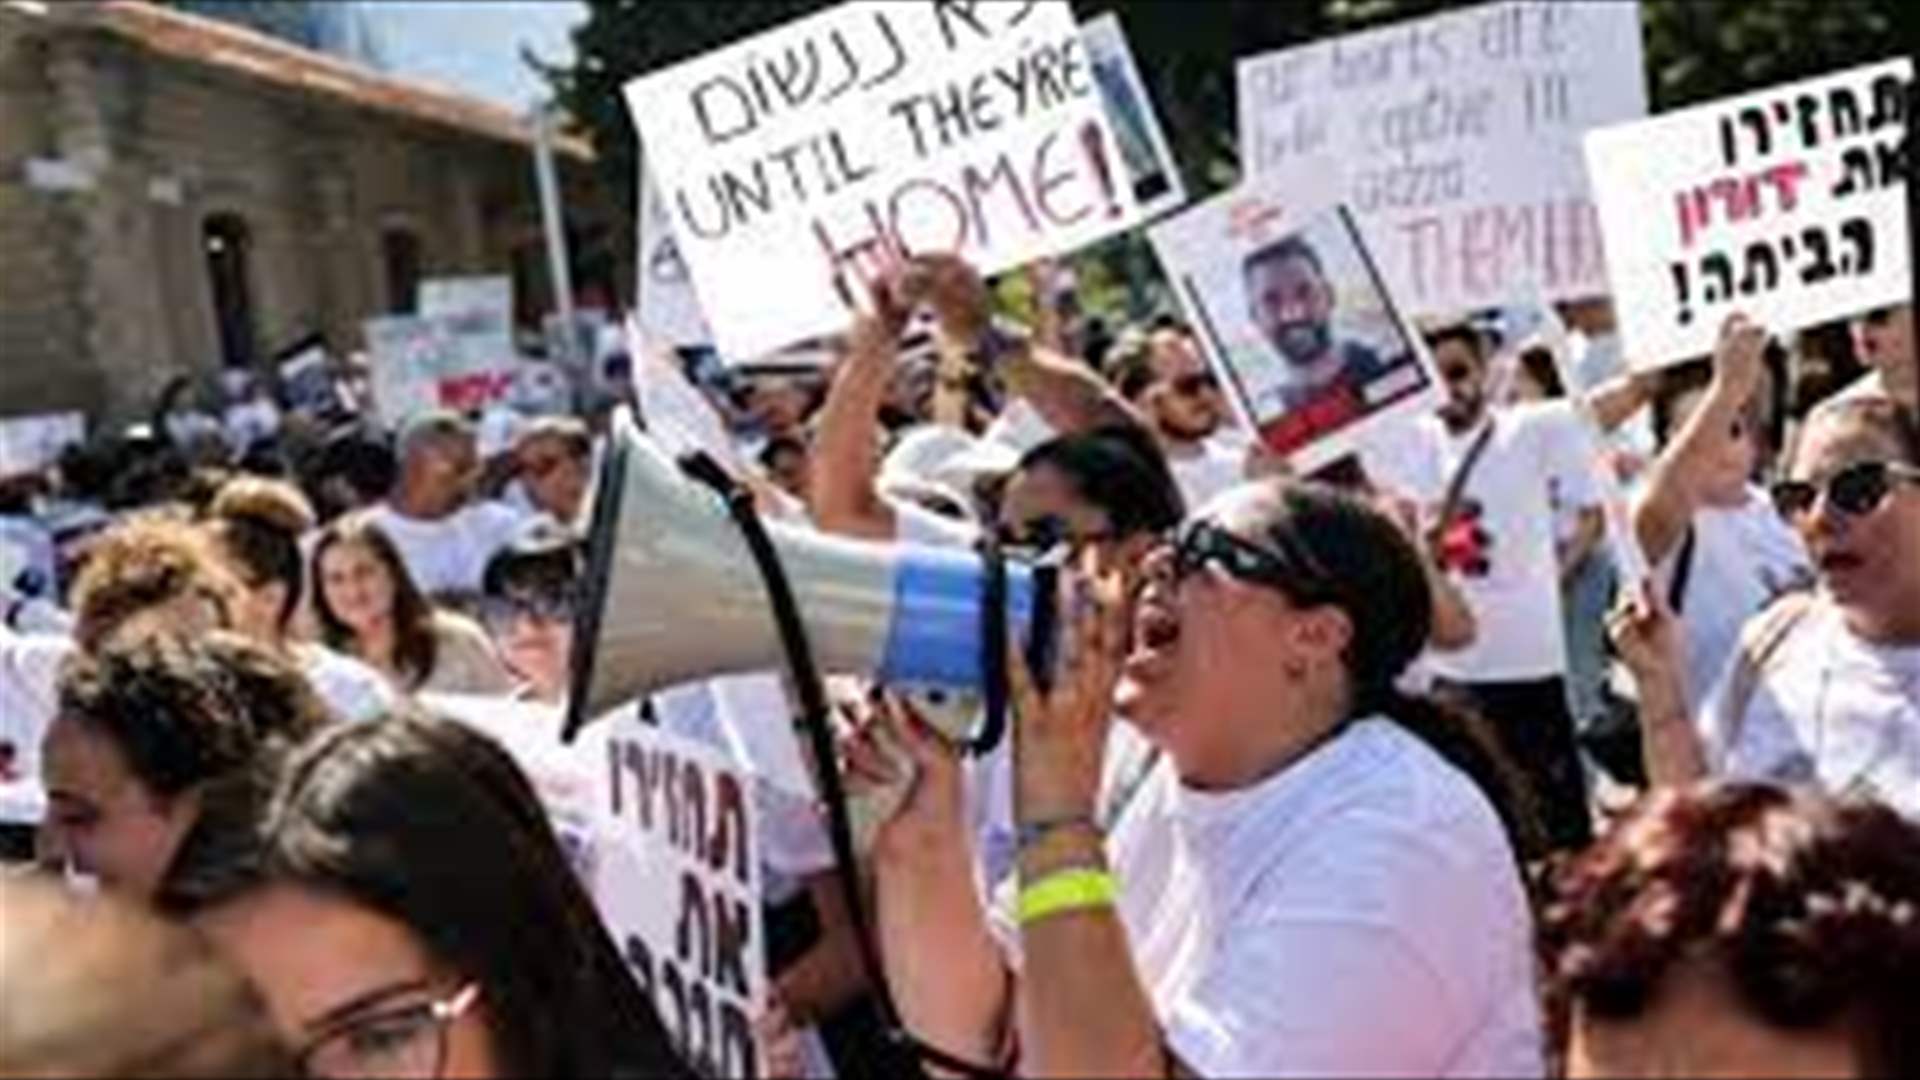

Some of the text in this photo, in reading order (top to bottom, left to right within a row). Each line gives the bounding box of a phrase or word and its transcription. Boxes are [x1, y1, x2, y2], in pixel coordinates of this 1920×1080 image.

[1719, 75, 1904, 166] תחזירו
[674, 128, 876, 240] UNTIL
[811, 116, 1122, 308] HOME!
[1671, 217, 1875, 325] הביתה!
[677, 872, 749, 998] את
